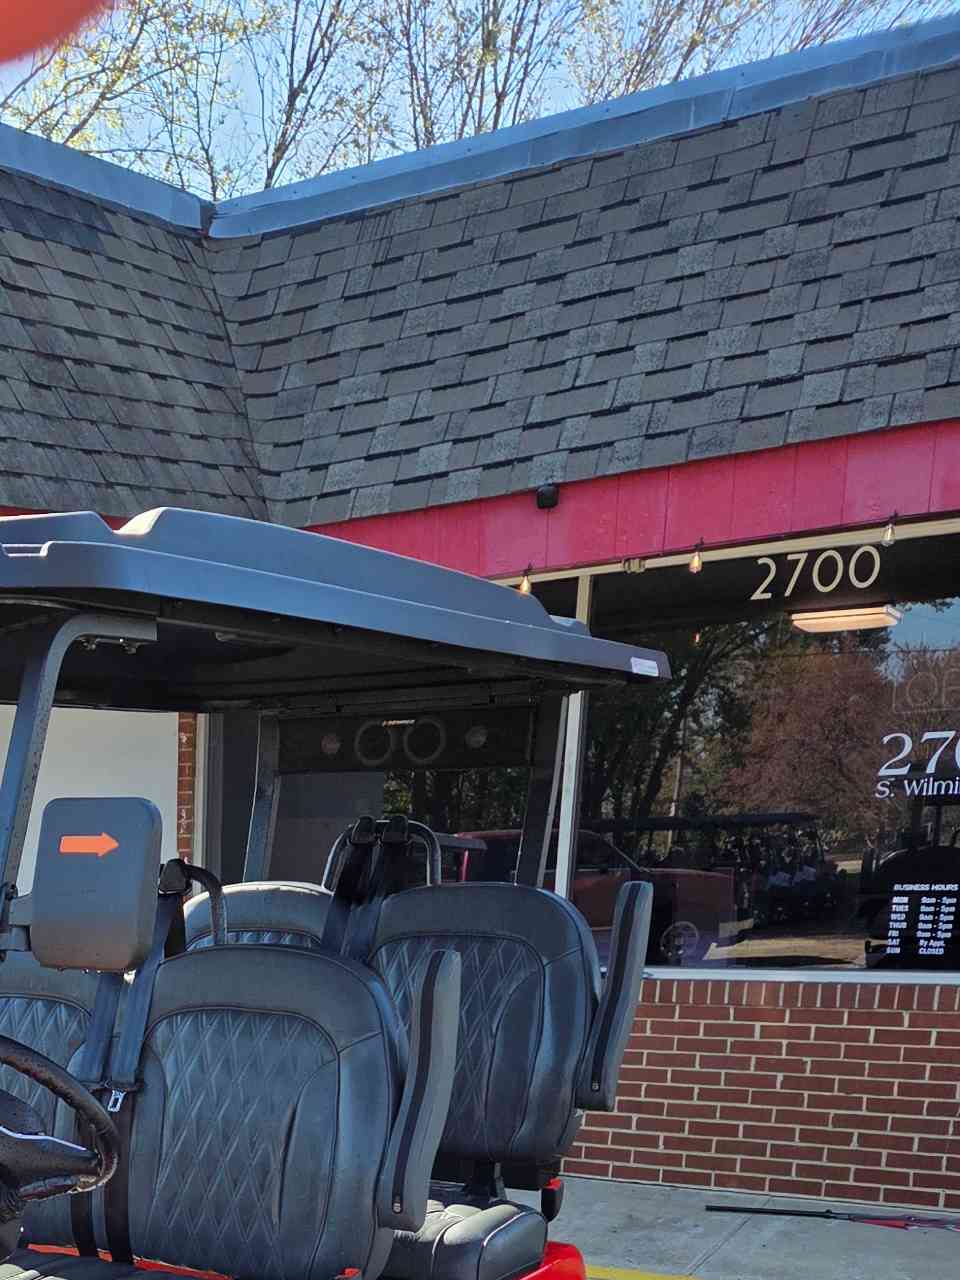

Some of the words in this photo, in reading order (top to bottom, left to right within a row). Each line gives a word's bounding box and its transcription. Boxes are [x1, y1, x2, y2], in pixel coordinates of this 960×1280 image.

[750, 545, 881, 600] 2700
[878, 731, 960, 777] 27
[904, 777, 960, 797] Wilmi
